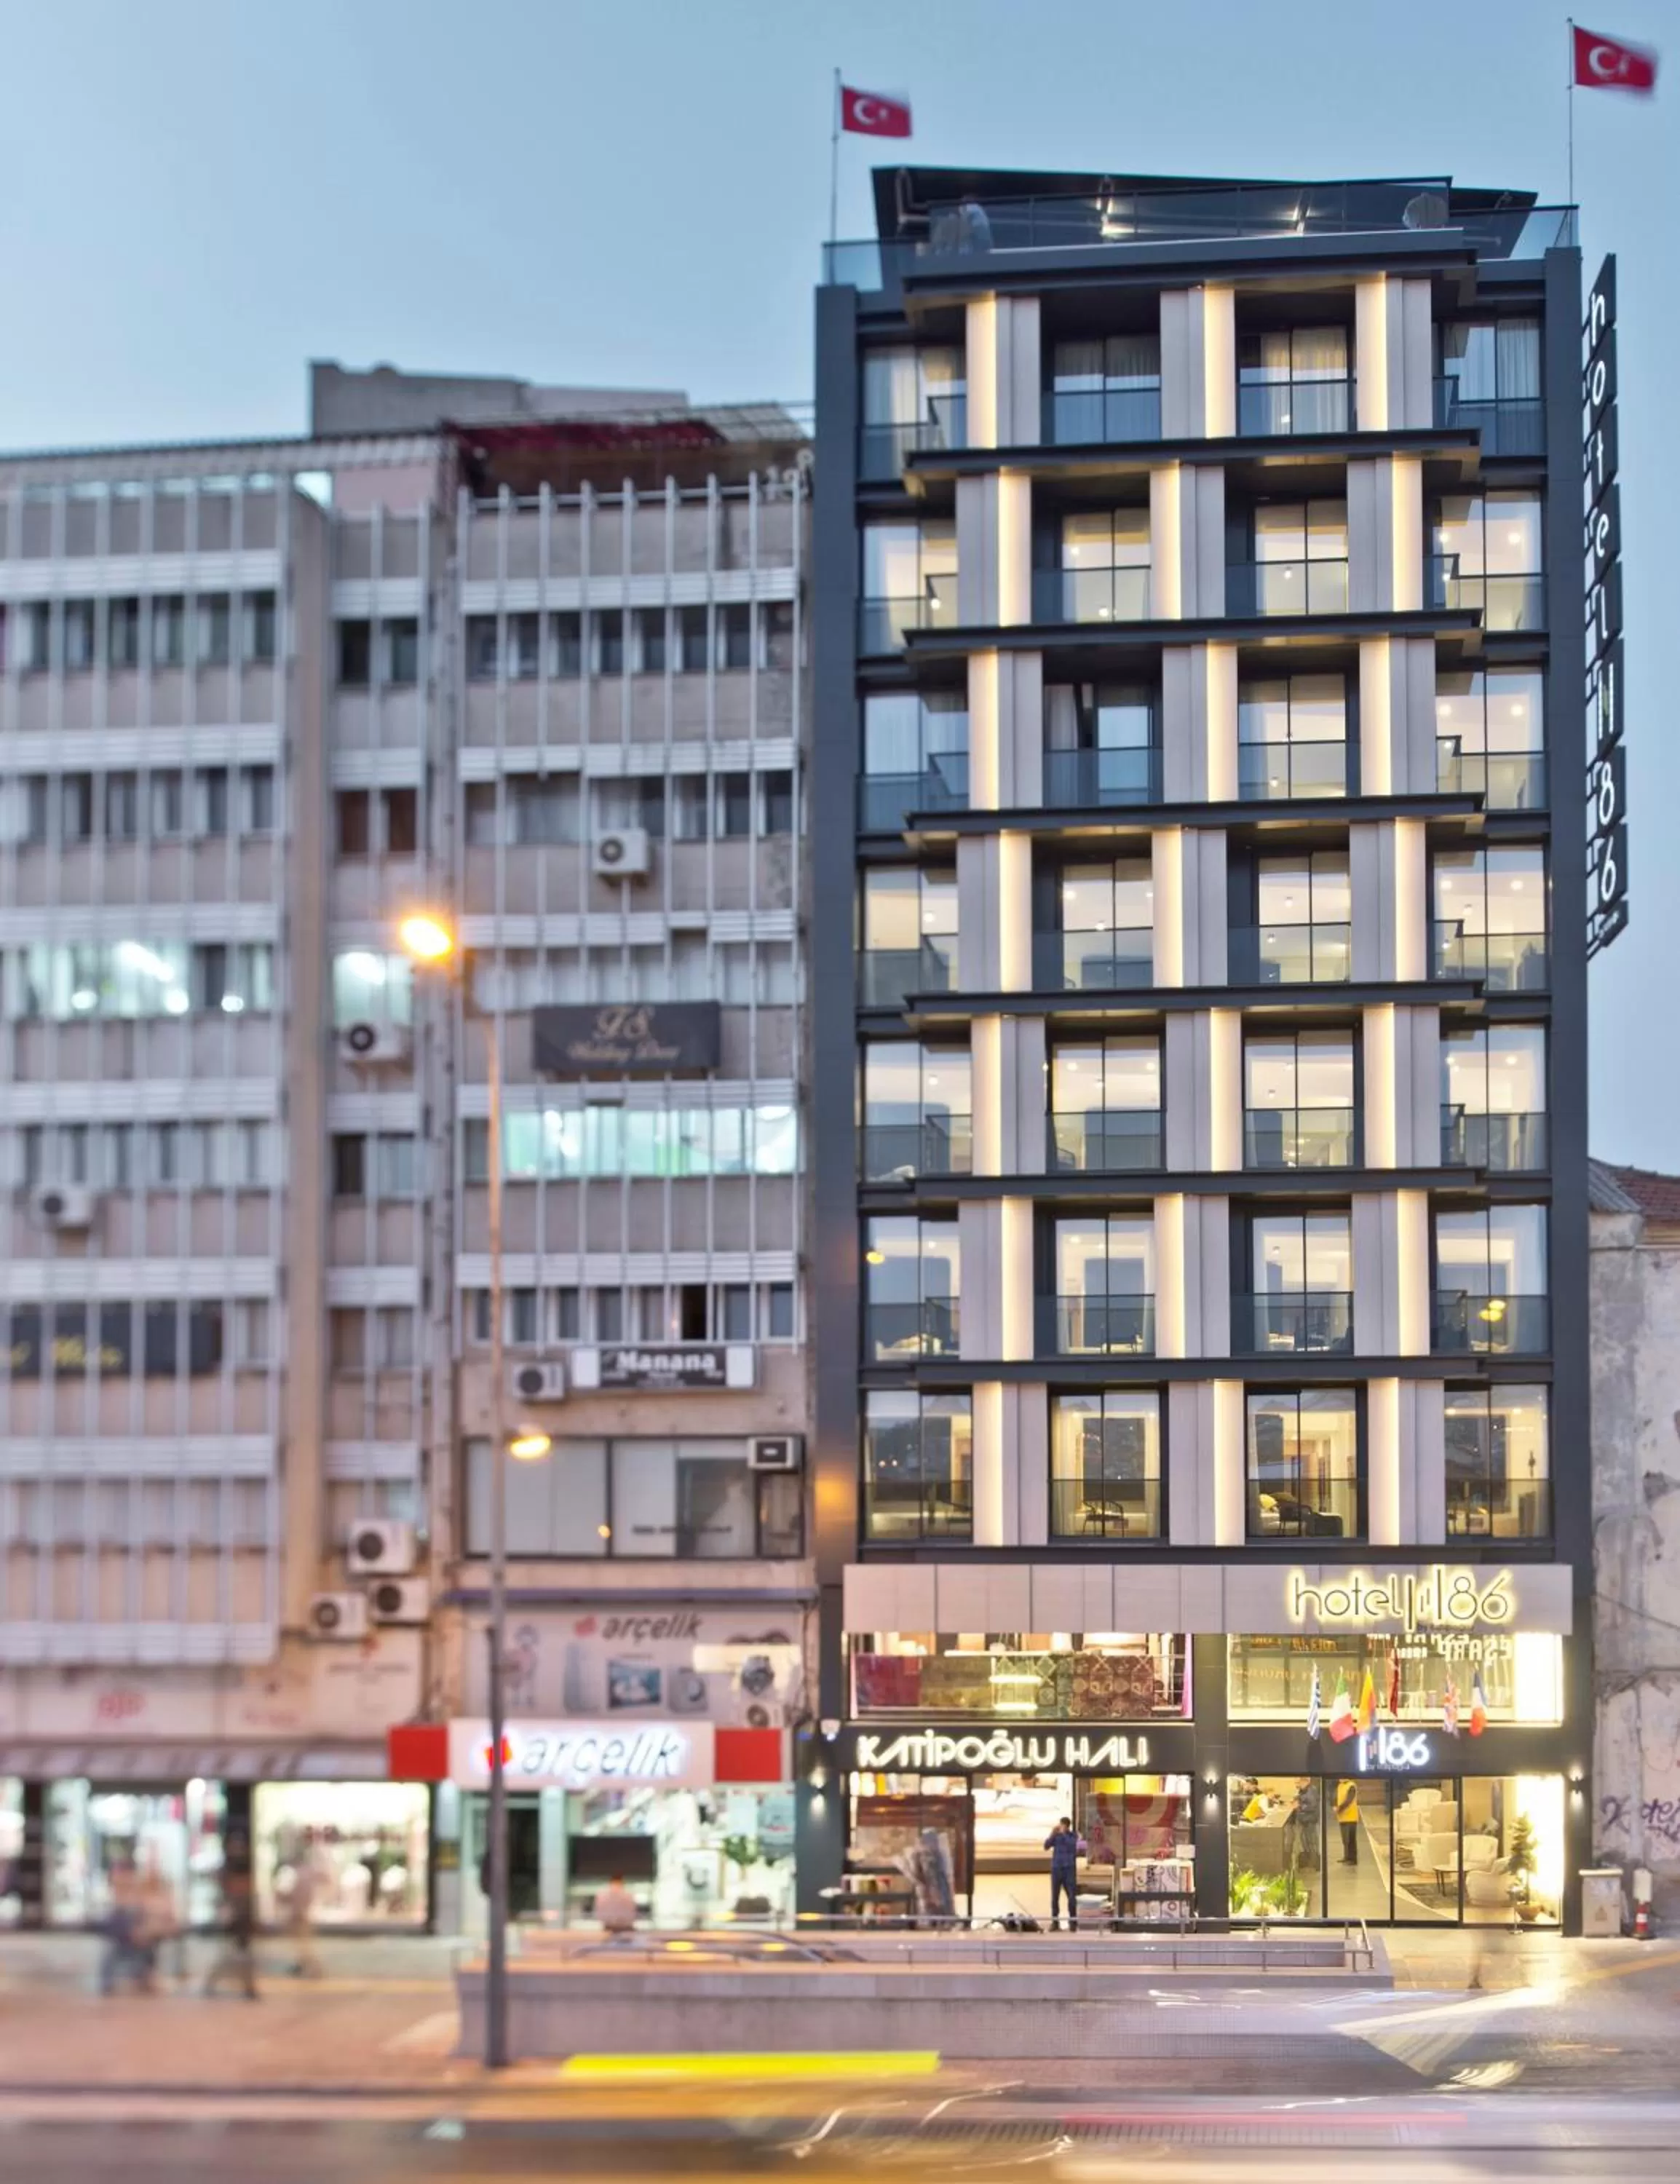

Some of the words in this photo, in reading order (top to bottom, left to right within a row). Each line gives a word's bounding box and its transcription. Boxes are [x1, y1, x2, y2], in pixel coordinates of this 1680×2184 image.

[1290, 1572, 1403, 1619] hotel
[602, 1613, 702, 1643] arçelik
[857, 1728, 1056, 1767] KATİPOĞLU
[1065, 1736, 1148, 1768] HALI
